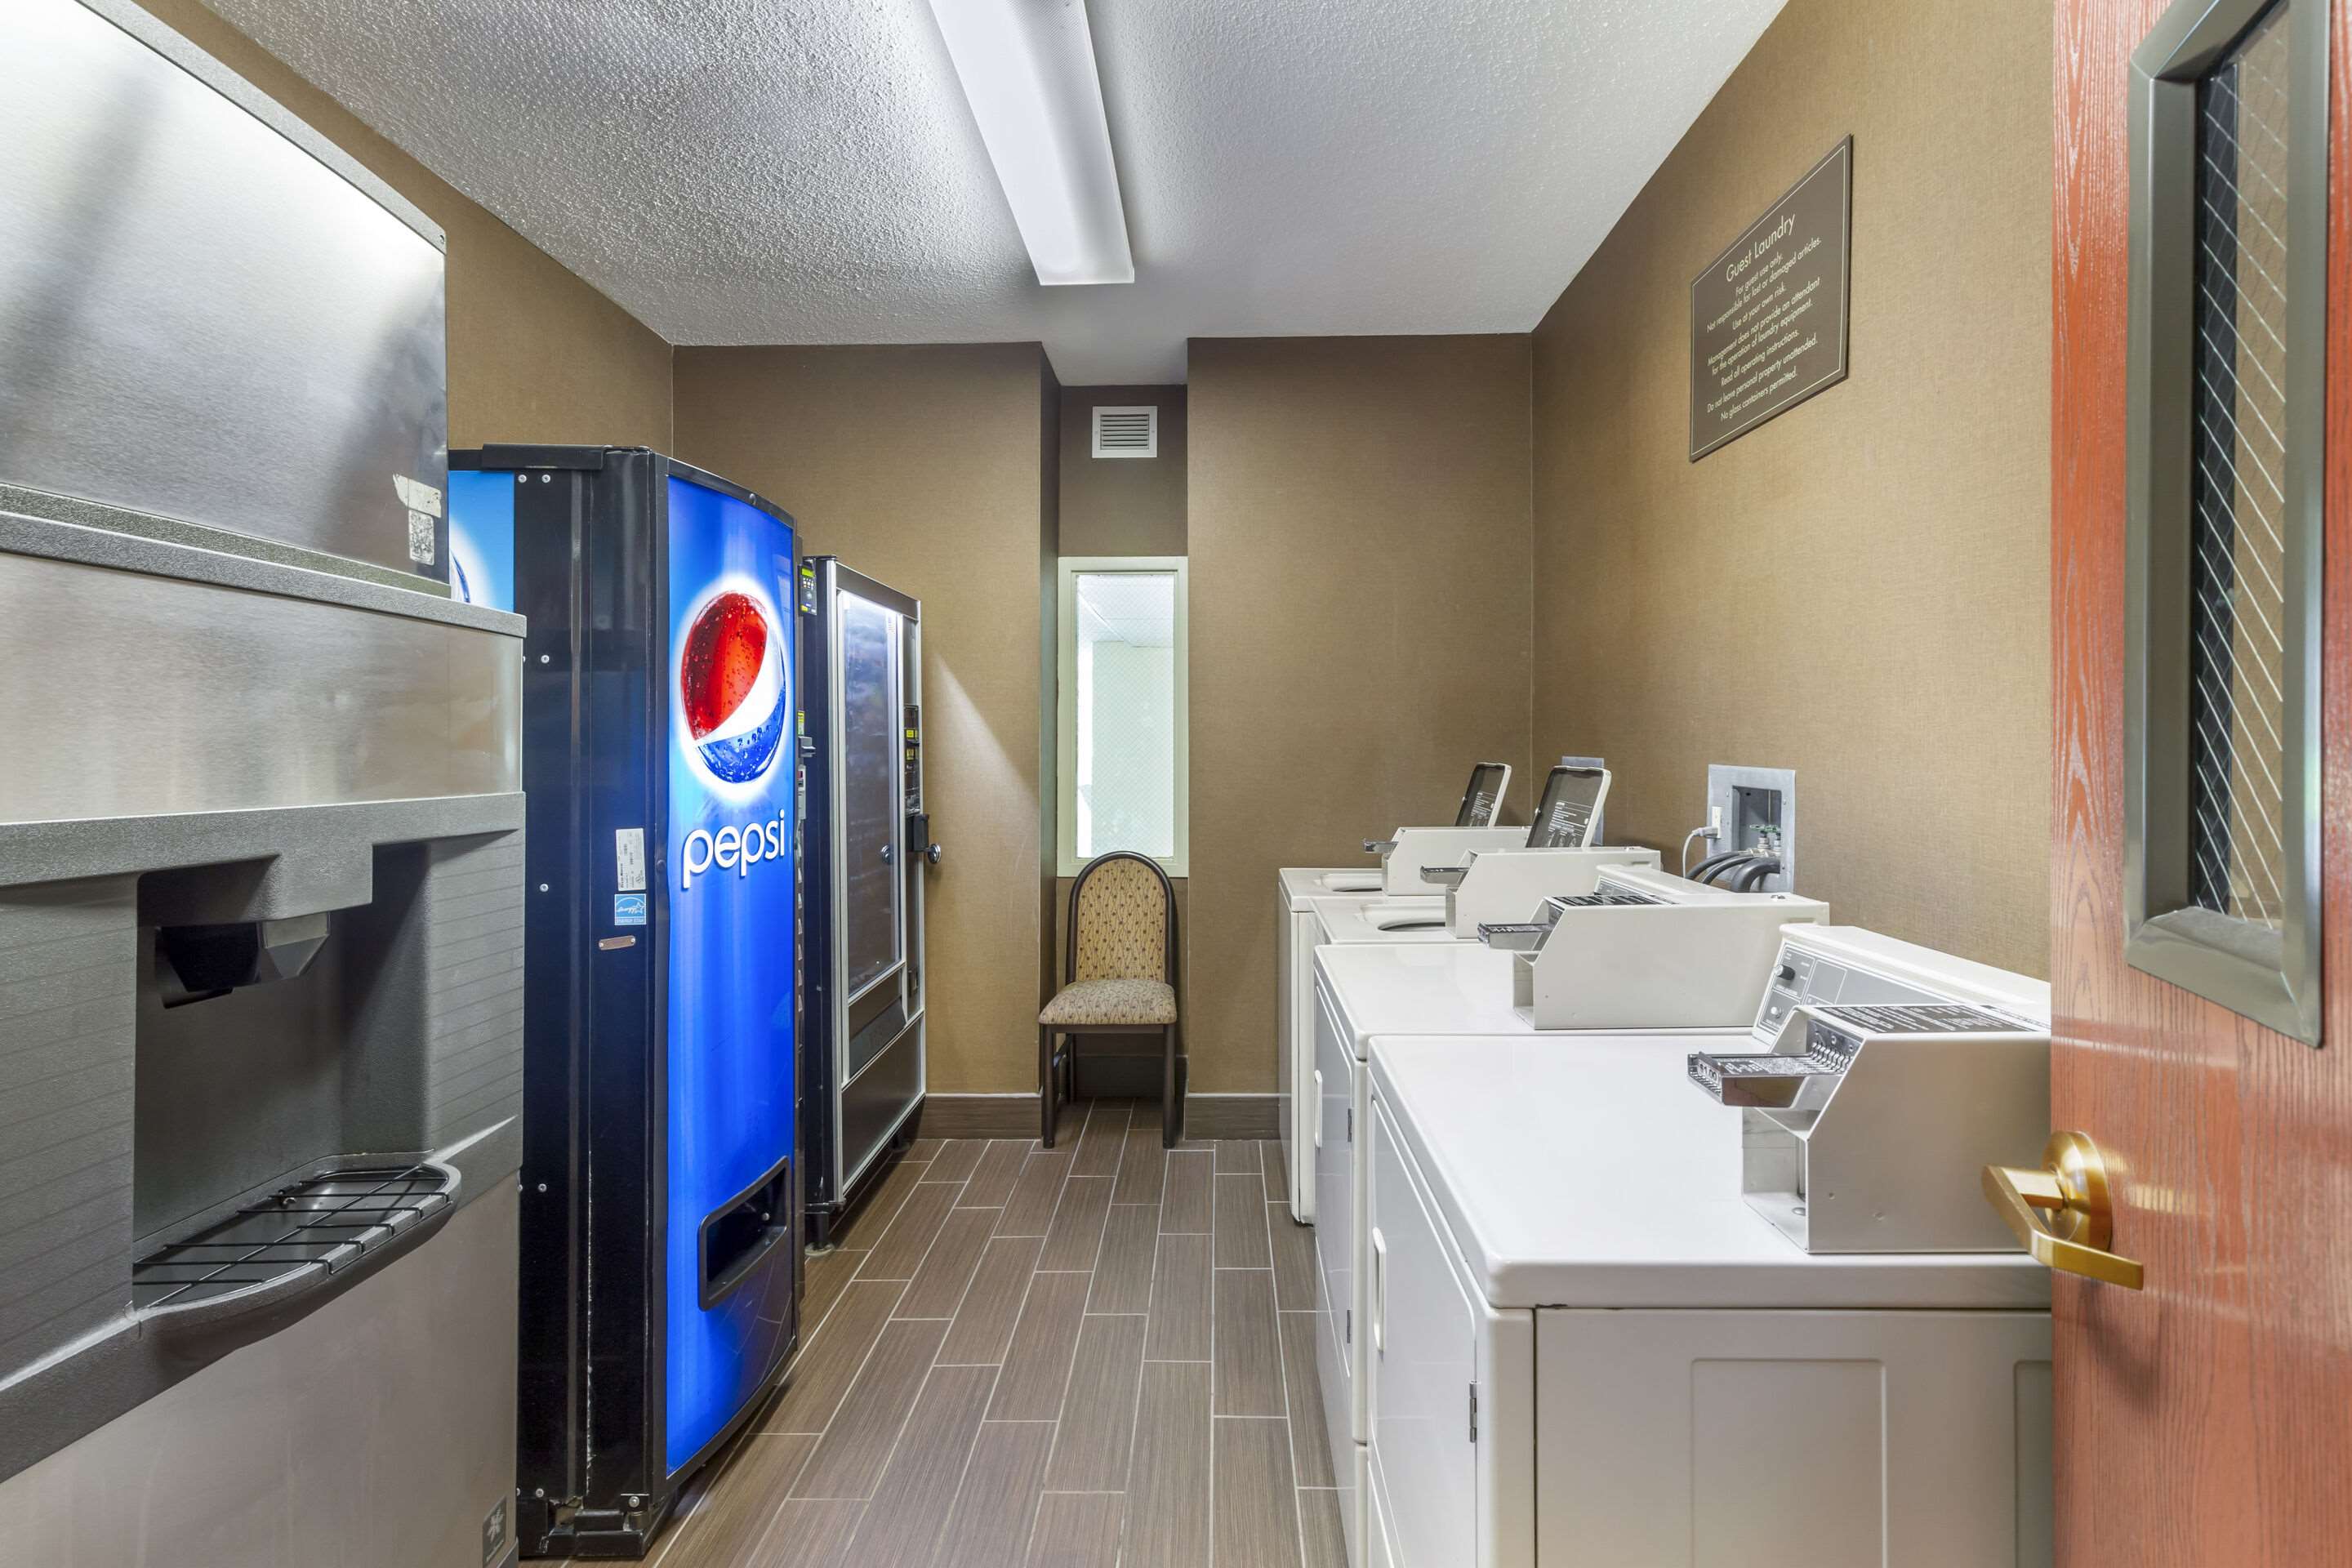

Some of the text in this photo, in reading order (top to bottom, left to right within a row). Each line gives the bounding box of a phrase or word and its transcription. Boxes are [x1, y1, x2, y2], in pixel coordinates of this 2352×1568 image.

[1726, 214, 1795, 282] Guest Laundry
[1707, 320, 1716, 333] Not
[1717, 298, 1743, 327] responsible
[1744, 292, 1752, 303] for
[1752, 283, 1761, 296] lost
[1762, 278, 1768, 288] or
[1769, 251, 1797, 283] damaged
[1736, 286, 1744, 297] For
[1744, 271, 1759, 292] guest
[1759, 265, 1769, 277] use
[1708, 276, 1820, 366] Management does not provide an attendant
[1732, 318, 1742, 330] Use
[1743, 312, 1748, 323] at
[1748, 303, 1761, 321] your
[1762, 294, 1773, 307] own
[1721, 370, 1733, 386] Read
[1741, 352, 1766, 373] operating
[1727, 344, 1750, 365] operation
[1752, 334, 1757, 347] of
[1757, 323, 1779, 343] laundry
[1707, 403, 1714, 412] Do
[1723, 391, 1735, 403] leave
[1736, 372, 1757, 397] personal
[1758, 359, 1782, 382] property
[1783, 332, 1818, 364] unattended.
[1721, 411, 1729, 421] No
[1729, 404, 1742, 419] glass
[1742, 387, 1769, 408] containers
[683, 808, 785, 889] pepsi
